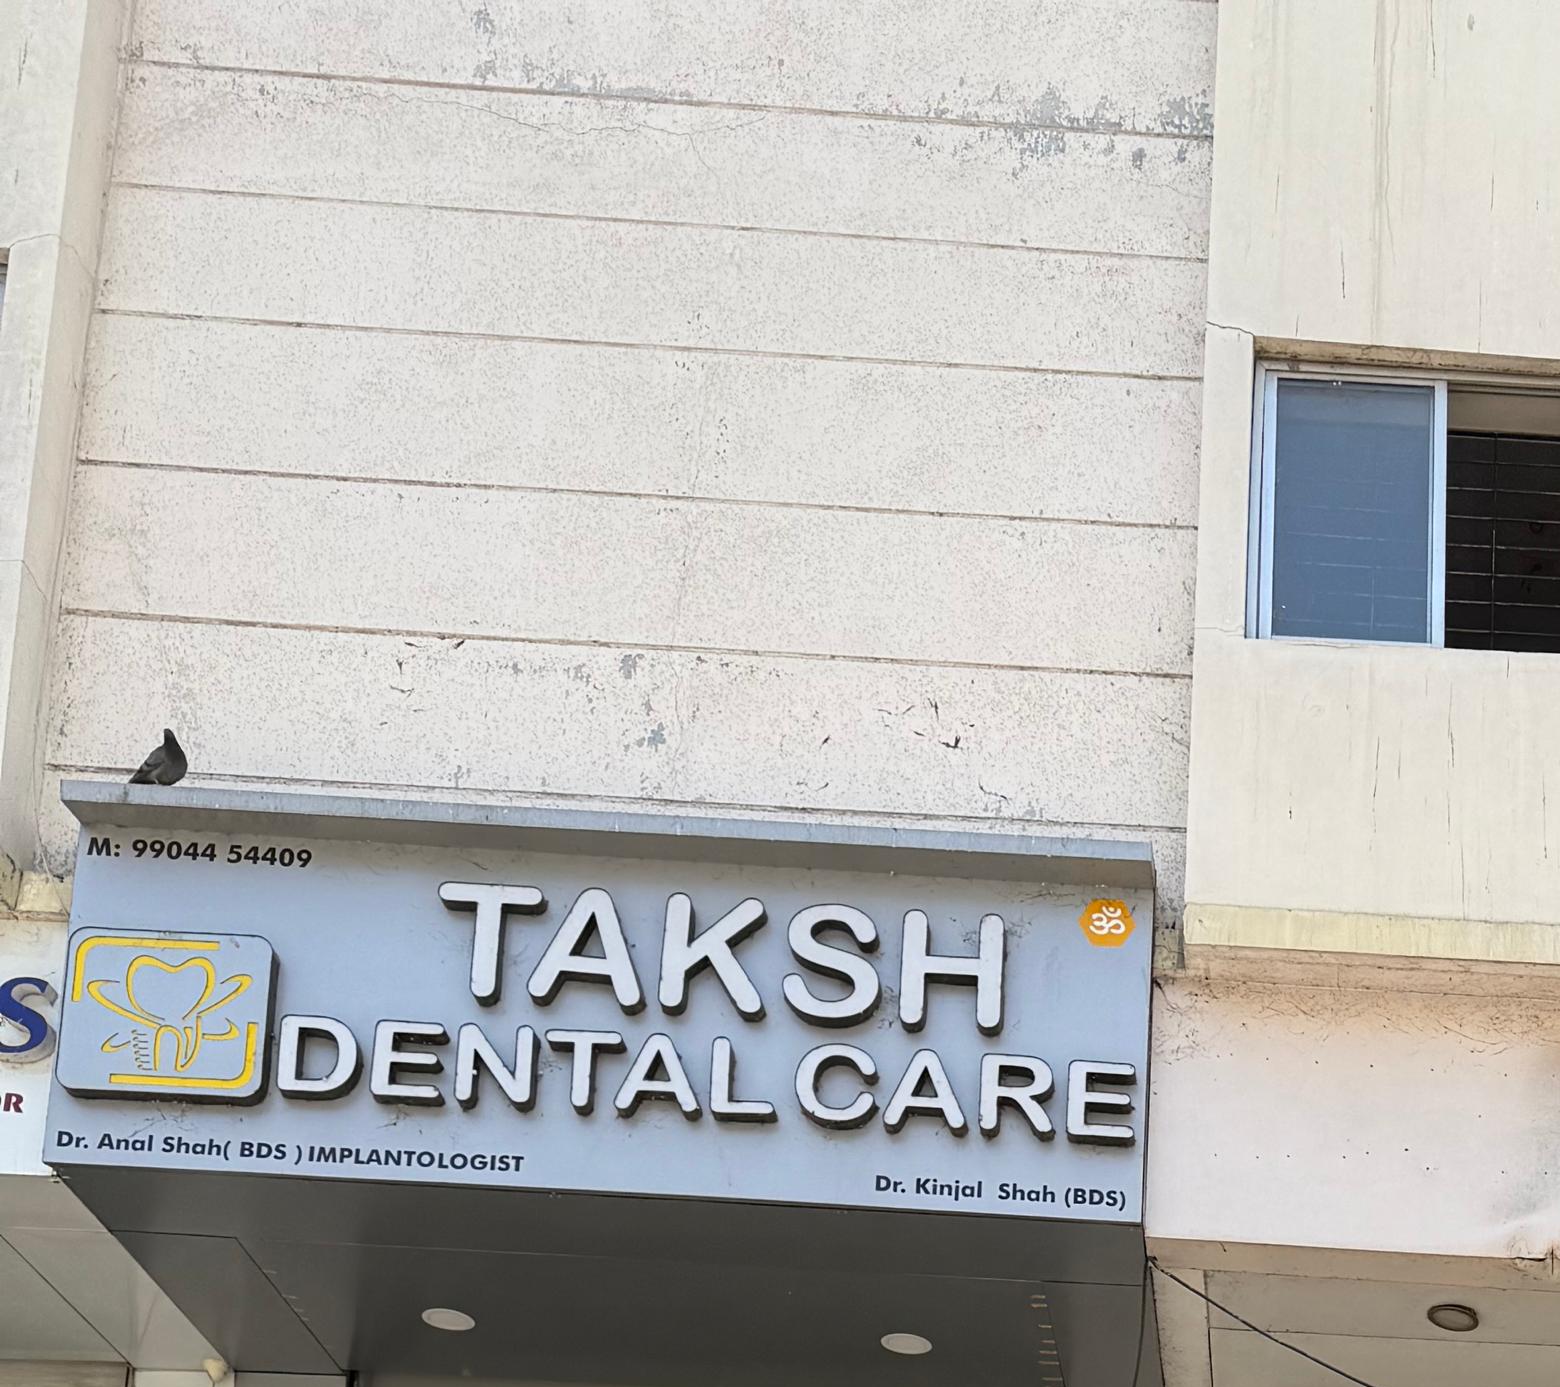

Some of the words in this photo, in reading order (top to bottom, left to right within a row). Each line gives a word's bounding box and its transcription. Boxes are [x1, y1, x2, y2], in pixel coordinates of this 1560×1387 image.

[87, 836, 121, 858] M:
[131, 838, 218, 863] 99044
[226, 844, 313, 869] 54409
[437, 881, 1006, 1036] TAKSH
[0, 1091, 24, 1113] R
[56, 1130, 89, 1151] Dr.
[97, 1132, 153, 1154] Anal
[308, 1145, 524, 1173] IMPLANTOLOGIST
[874, 1175, 906, 1194] Dr.
[915, 1176, 983, 1201] Kinjal
[998, 1183, 1057, 1204] Shah
[1063, 1186, 1126, 1211] (BDS)
